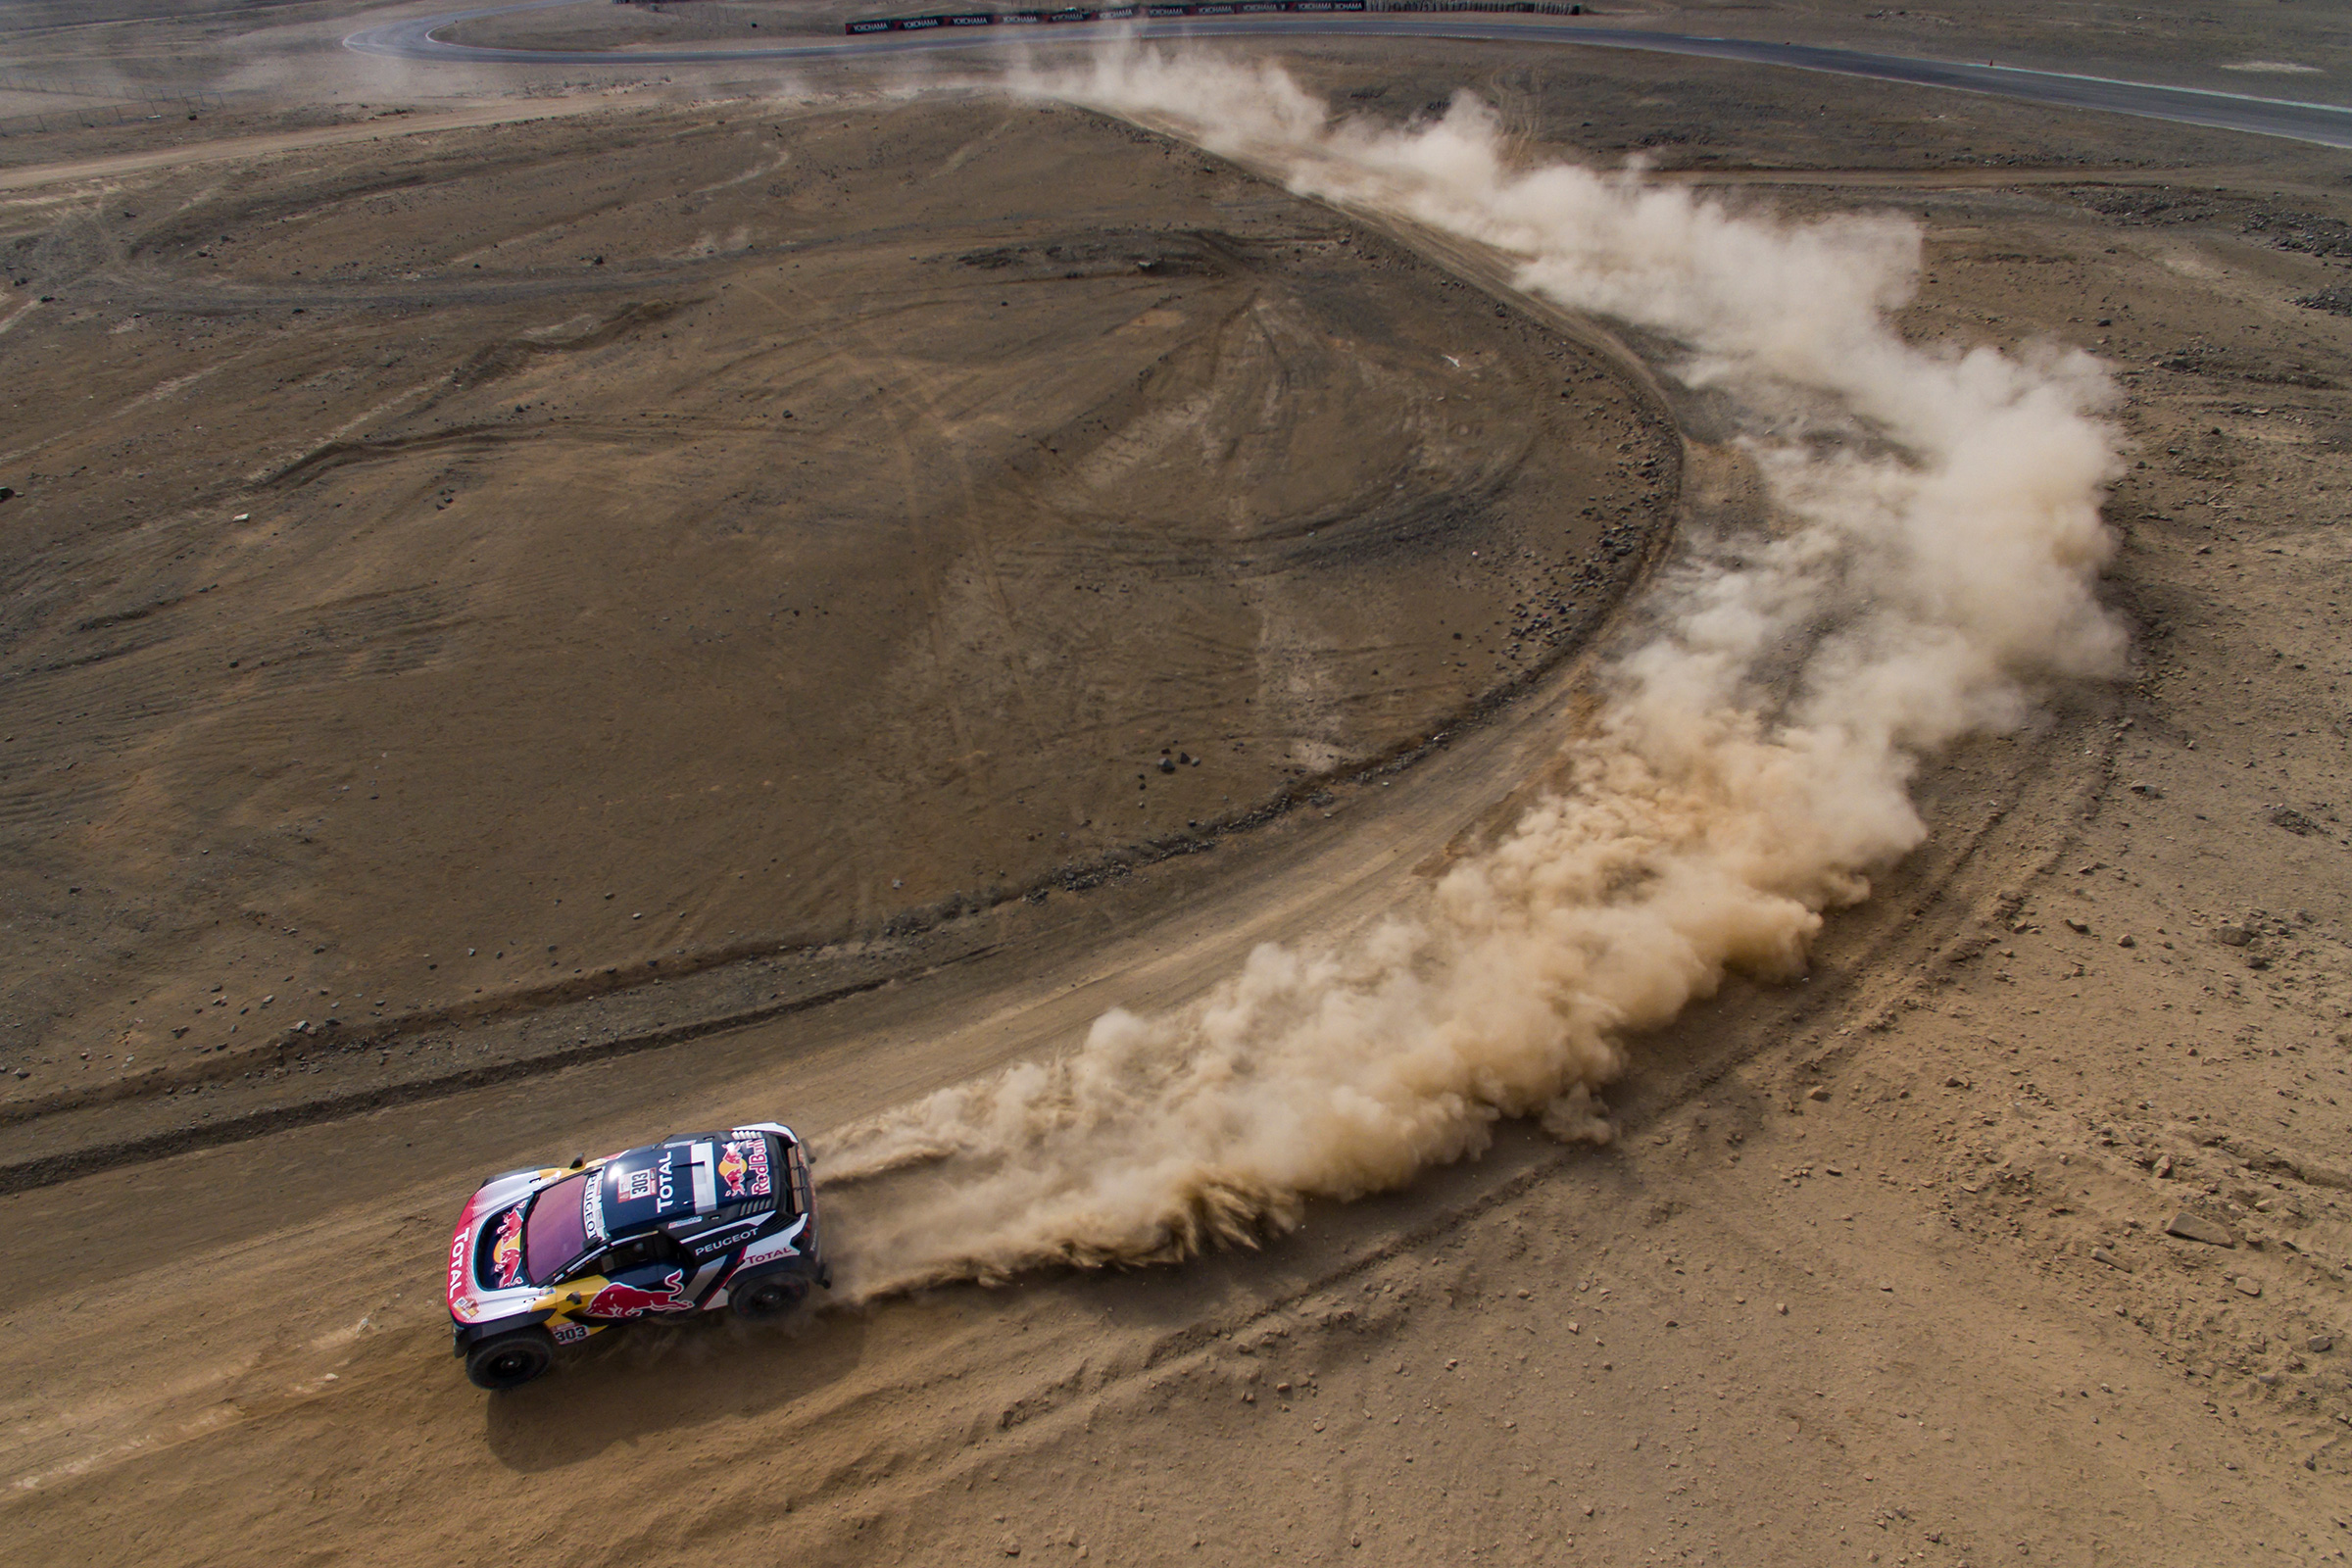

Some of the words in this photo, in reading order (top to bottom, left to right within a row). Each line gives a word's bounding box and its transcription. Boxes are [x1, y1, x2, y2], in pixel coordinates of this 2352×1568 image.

[854, 23, 888, 31] YOKOHAMA
[903, 19, 938, 29] YOKOHAMA
[631, 1172, 649, 1195] 303
[657, 1152, 673, 1213] TOTAL
[585, 1174, 598, 1239] PEUGEOT
[695, 1228, 759, 1255] PEUGEOT
[449, 1227, 470, 1299] TOTAL
[745, 1247, 792, 1264] TOTAL
[555, 1326, 587, 1341] 303
